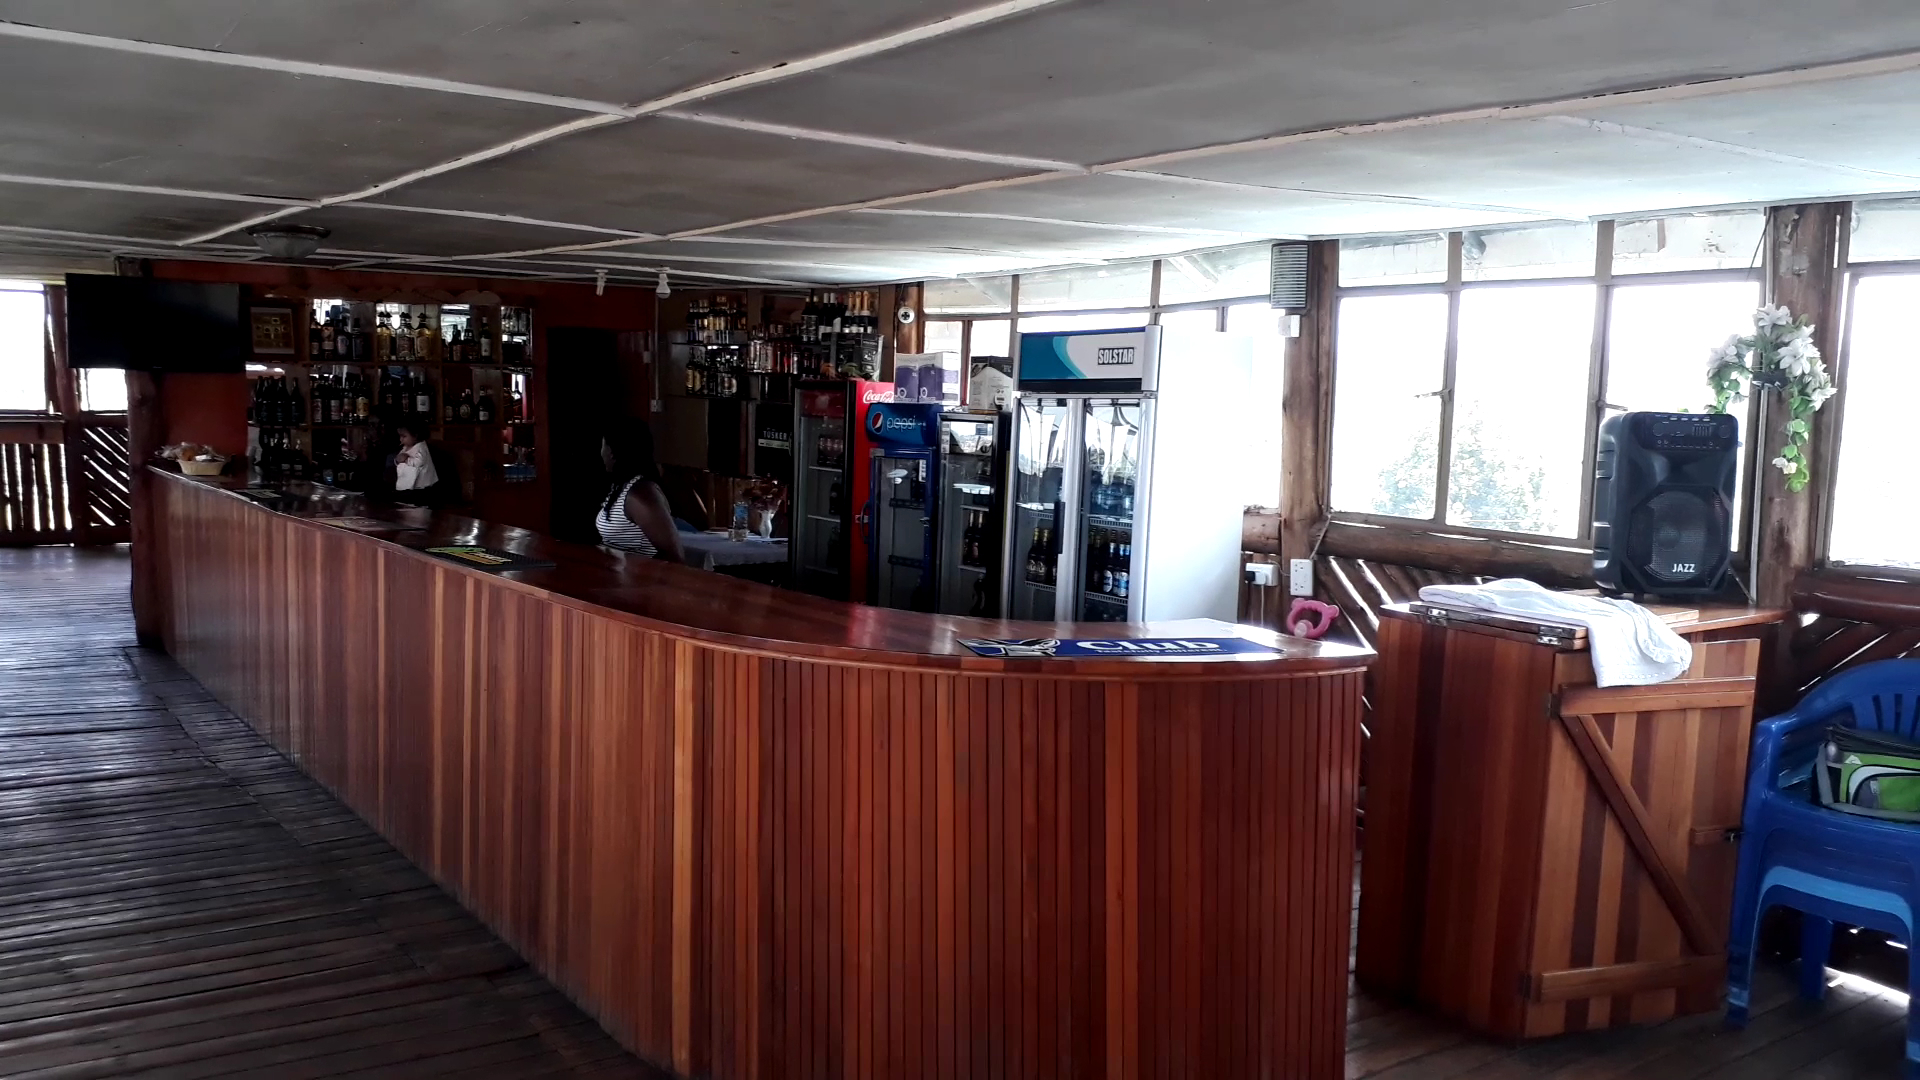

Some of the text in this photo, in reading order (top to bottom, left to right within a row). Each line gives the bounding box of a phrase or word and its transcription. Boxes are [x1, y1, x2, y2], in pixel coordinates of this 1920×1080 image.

[1098, 349, 1134, 364] SOLSTAR
[886, 415, 916, 432] pepsi
[762, 430, 788, 441] TUSKER
[1672, 563, 1695, 573] JAZZ
[1076, 640, 1220, 650] Club
